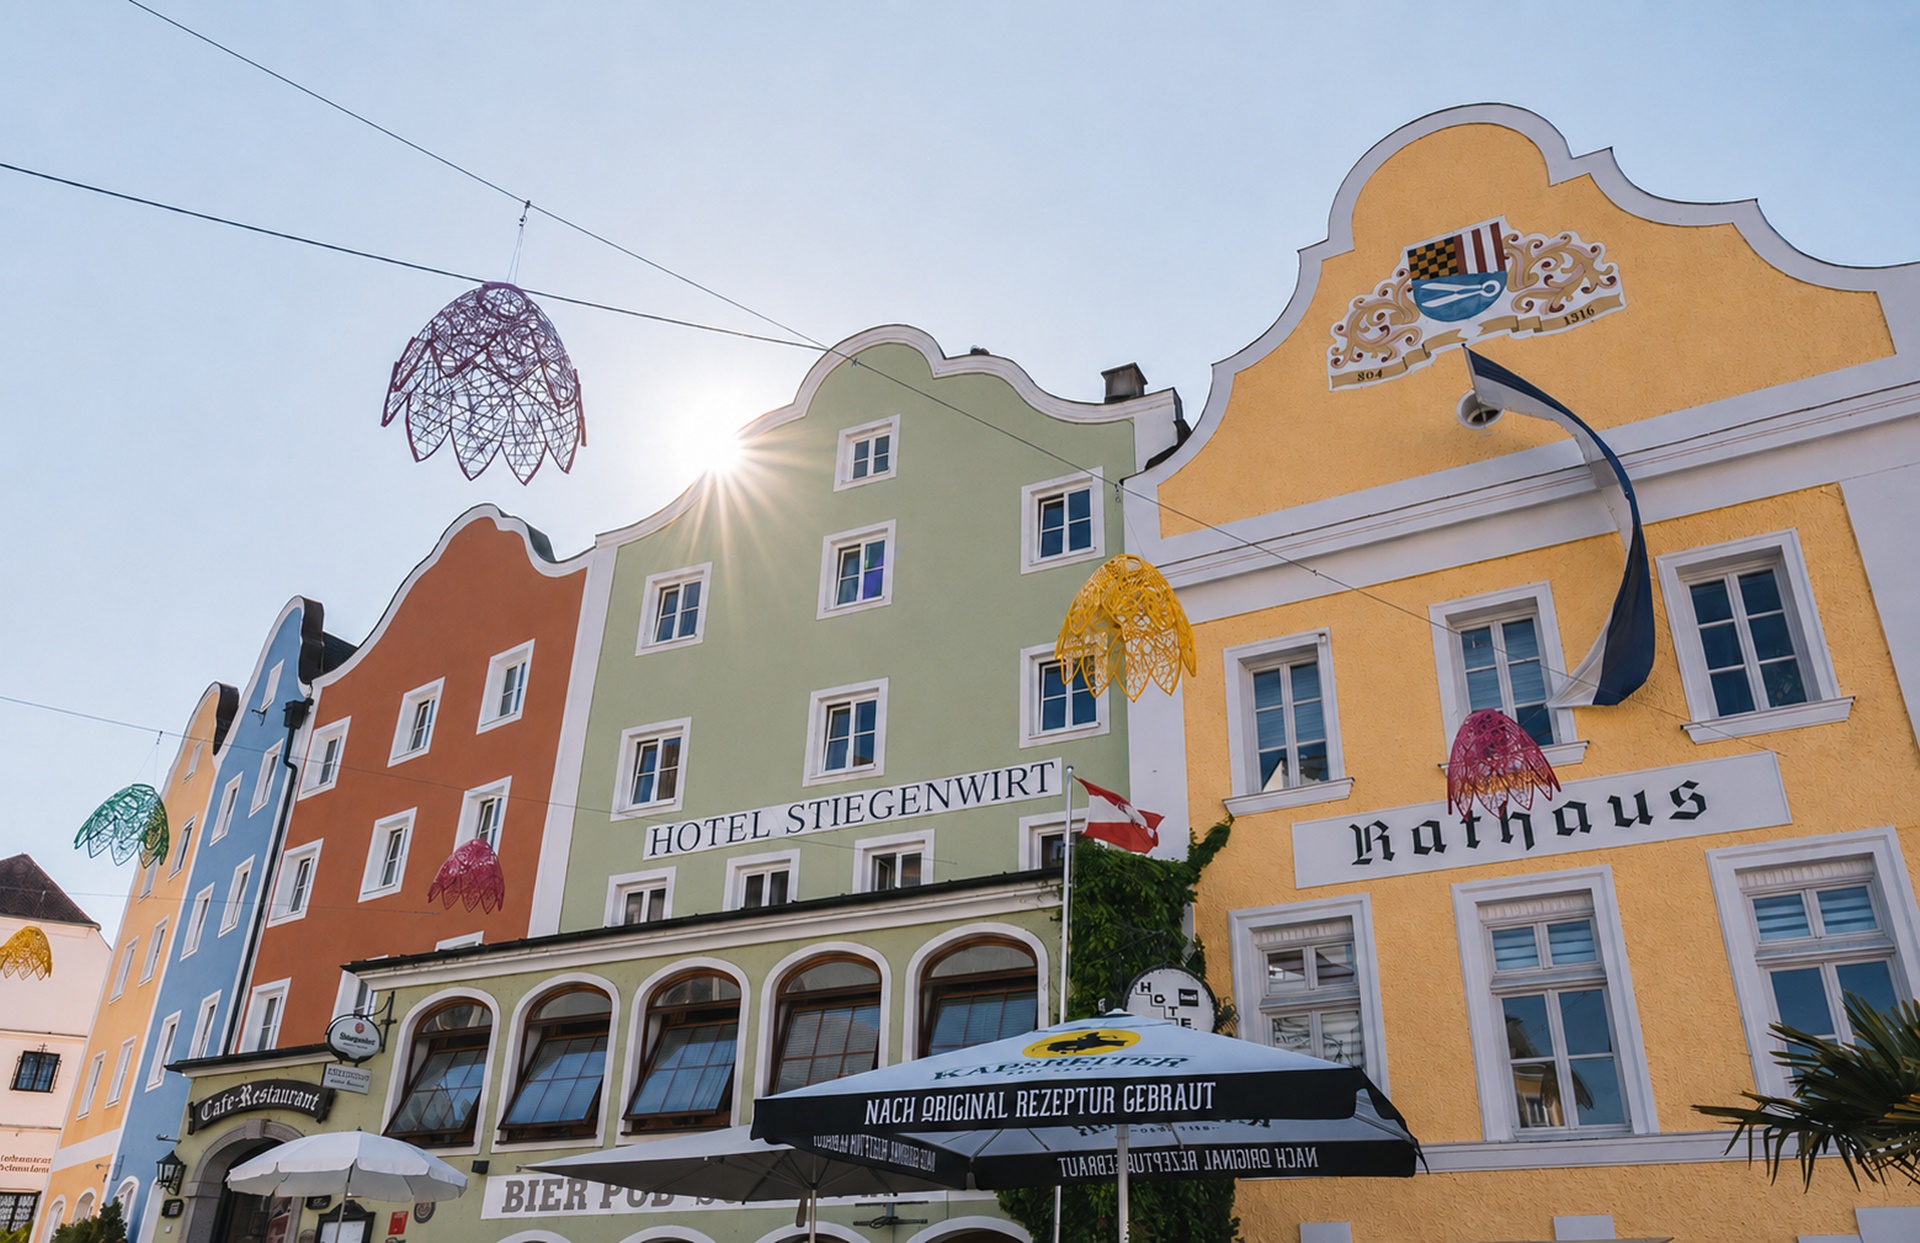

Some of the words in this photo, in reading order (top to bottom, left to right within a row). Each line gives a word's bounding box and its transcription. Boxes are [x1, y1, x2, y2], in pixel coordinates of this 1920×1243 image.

[649, 810, 771, 856] HOTEL
[786, 762, 1055, 834] STIEGENWIRT
[1349, 780, 1707, 865] Rathaus
[1140, 982, 1198, 1031] HOTE
[201, 1085, 319, 1120] Cafe-Restaurant
[864, 1097, 914, 1125] NACH
[922, 1091, 1008, 1121] ORIGINAL
[1015, 1086, 1115, 1117] REZEPTUR
[1124, 1082, 1216, 1113] GEBRAUT
[501, 1178, 588, 1213] BIER
